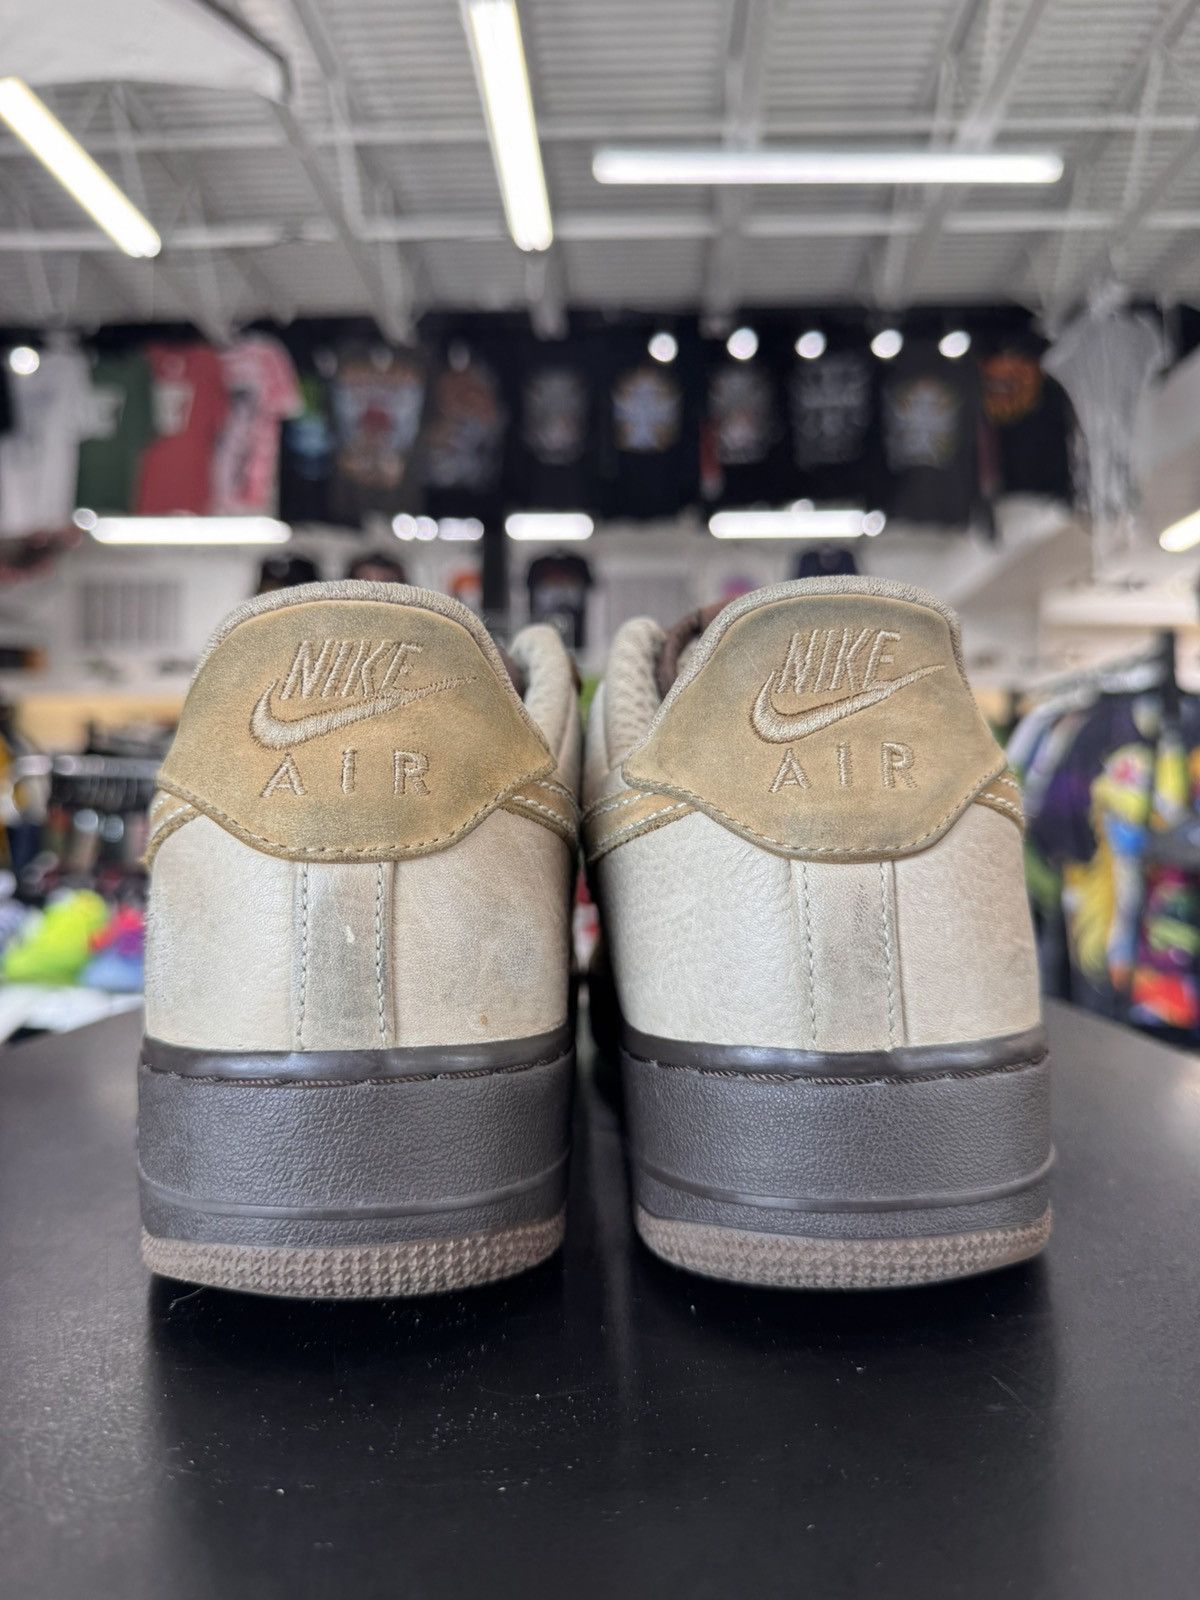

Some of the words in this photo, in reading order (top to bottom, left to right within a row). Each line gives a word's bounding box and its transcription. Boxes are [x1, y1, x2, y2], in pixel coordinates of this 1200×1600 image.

[280, 640, 424, 700] NIKE
[776, 628, 901, 695] NIKE
[260, 748, 431, 797] AIR
[768, 741, 918, 793] AIR
